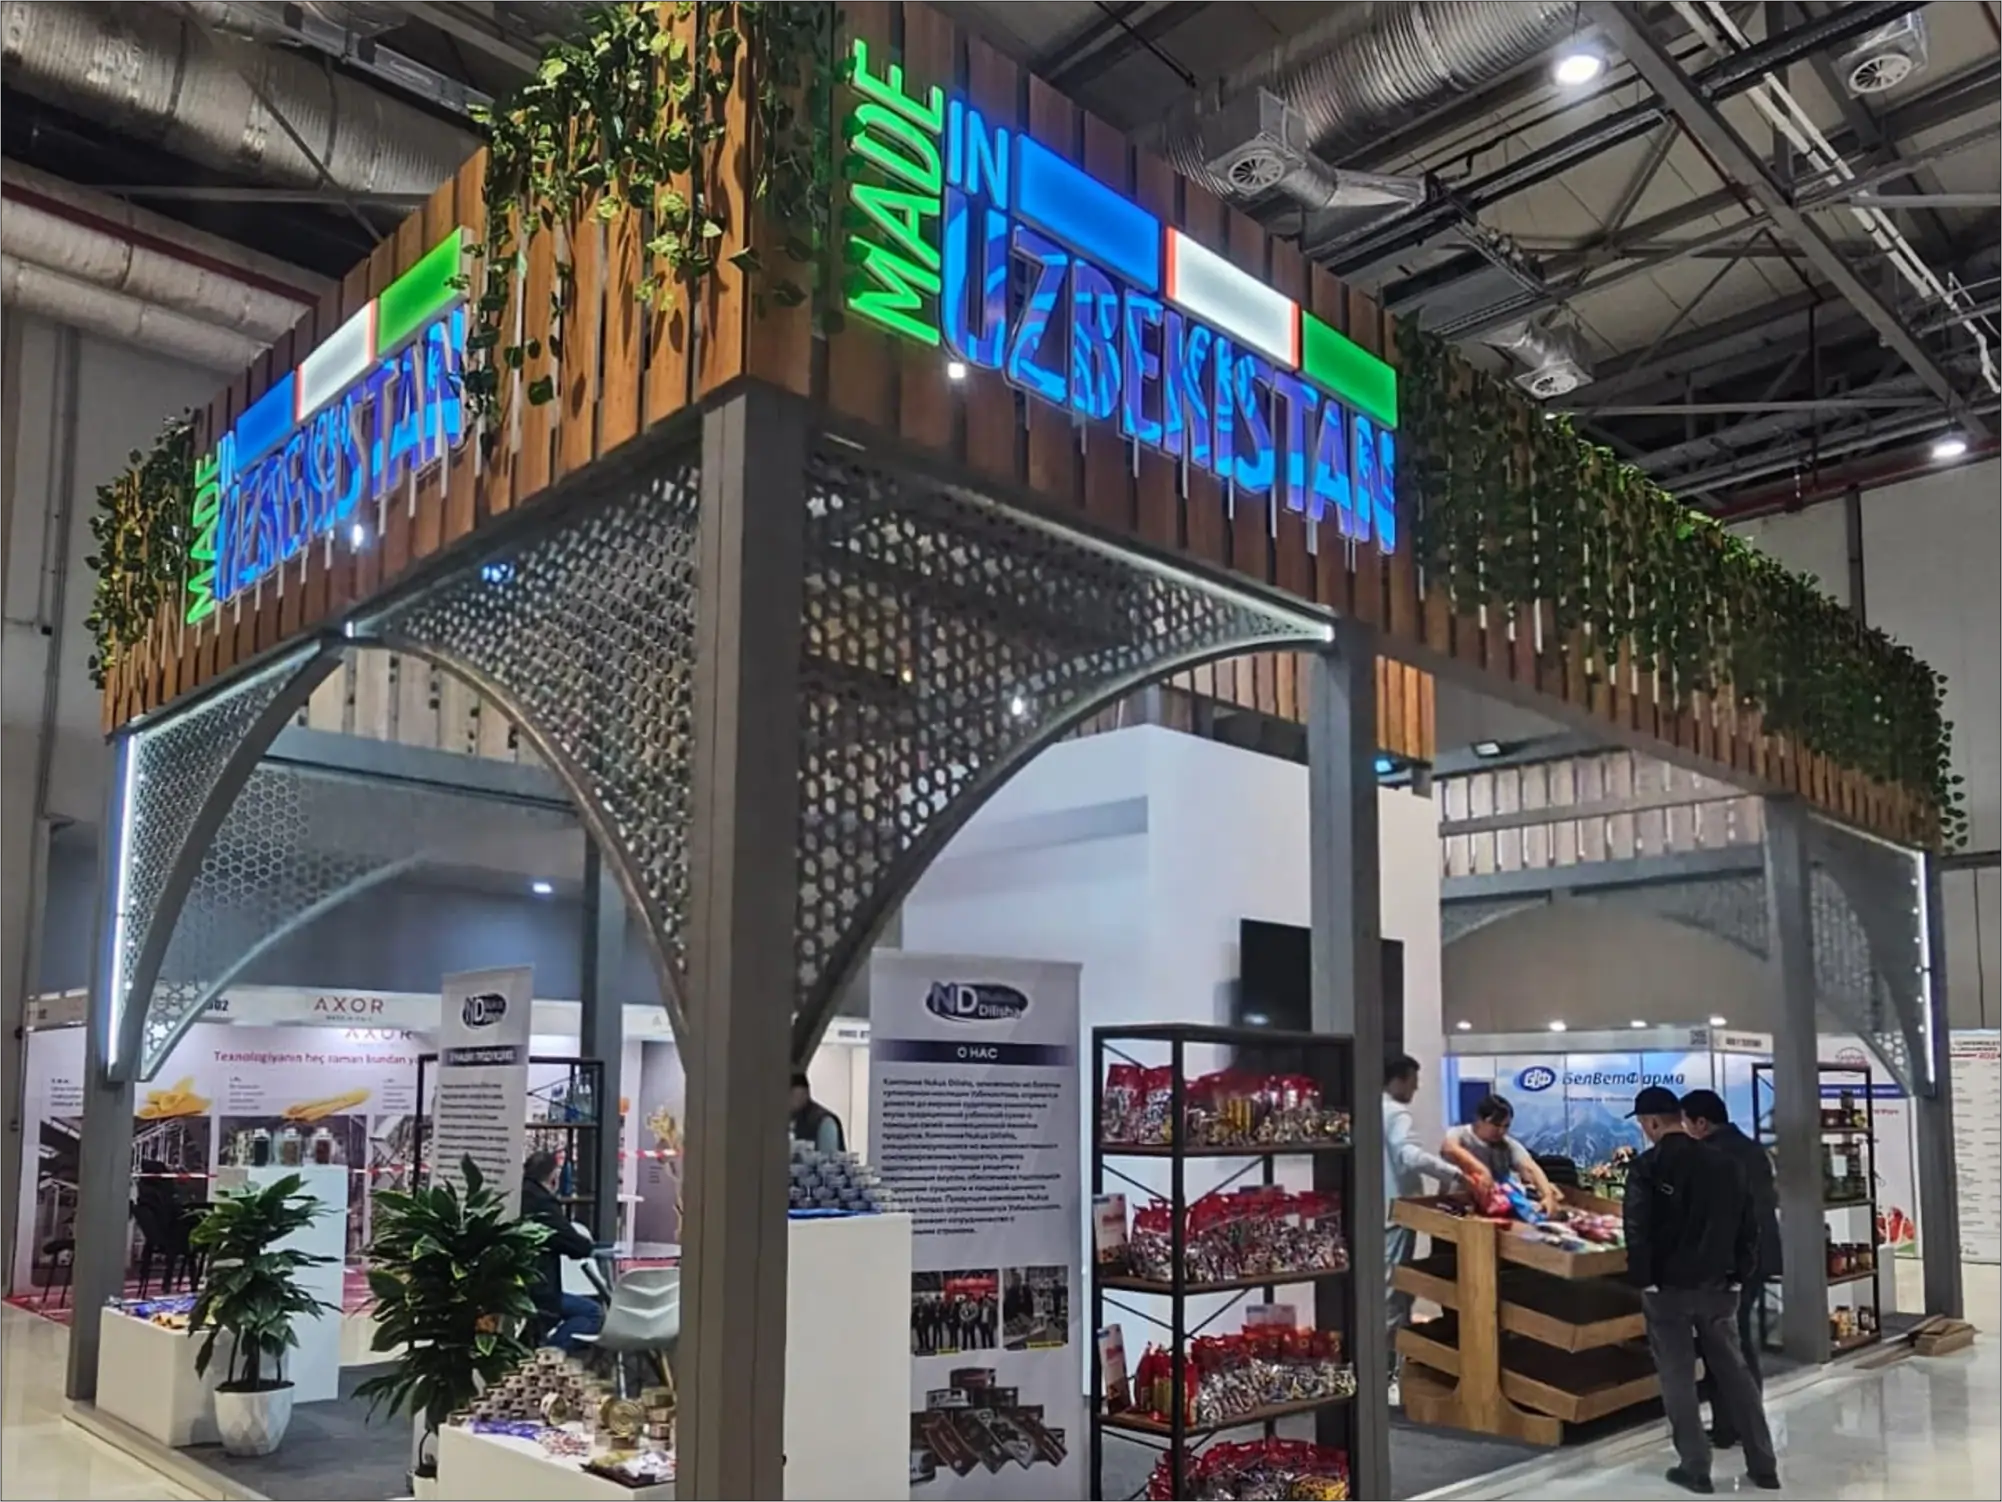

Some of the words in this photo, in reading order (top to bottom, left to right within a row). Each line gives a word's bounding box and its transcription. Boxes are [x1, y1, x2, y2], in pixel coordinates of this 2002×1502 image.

[848, 38, 943, 346] MADE
[948, 99, 1009, 211] IN
[941, 184, 1397, 557] UZBEKISTAN
[213, 301, 468, 605] UZBEKISTAN
[186, 451, 220, 625] MADE
[314, 997, 384, 1014] AXOR
[932, 981, 979, 1015] ND
[957, 1046, 969, 1059] О
[970, 1046, 998, 1060] НАС
[1562, 1071, 1685, 1088] БелВетФарма
